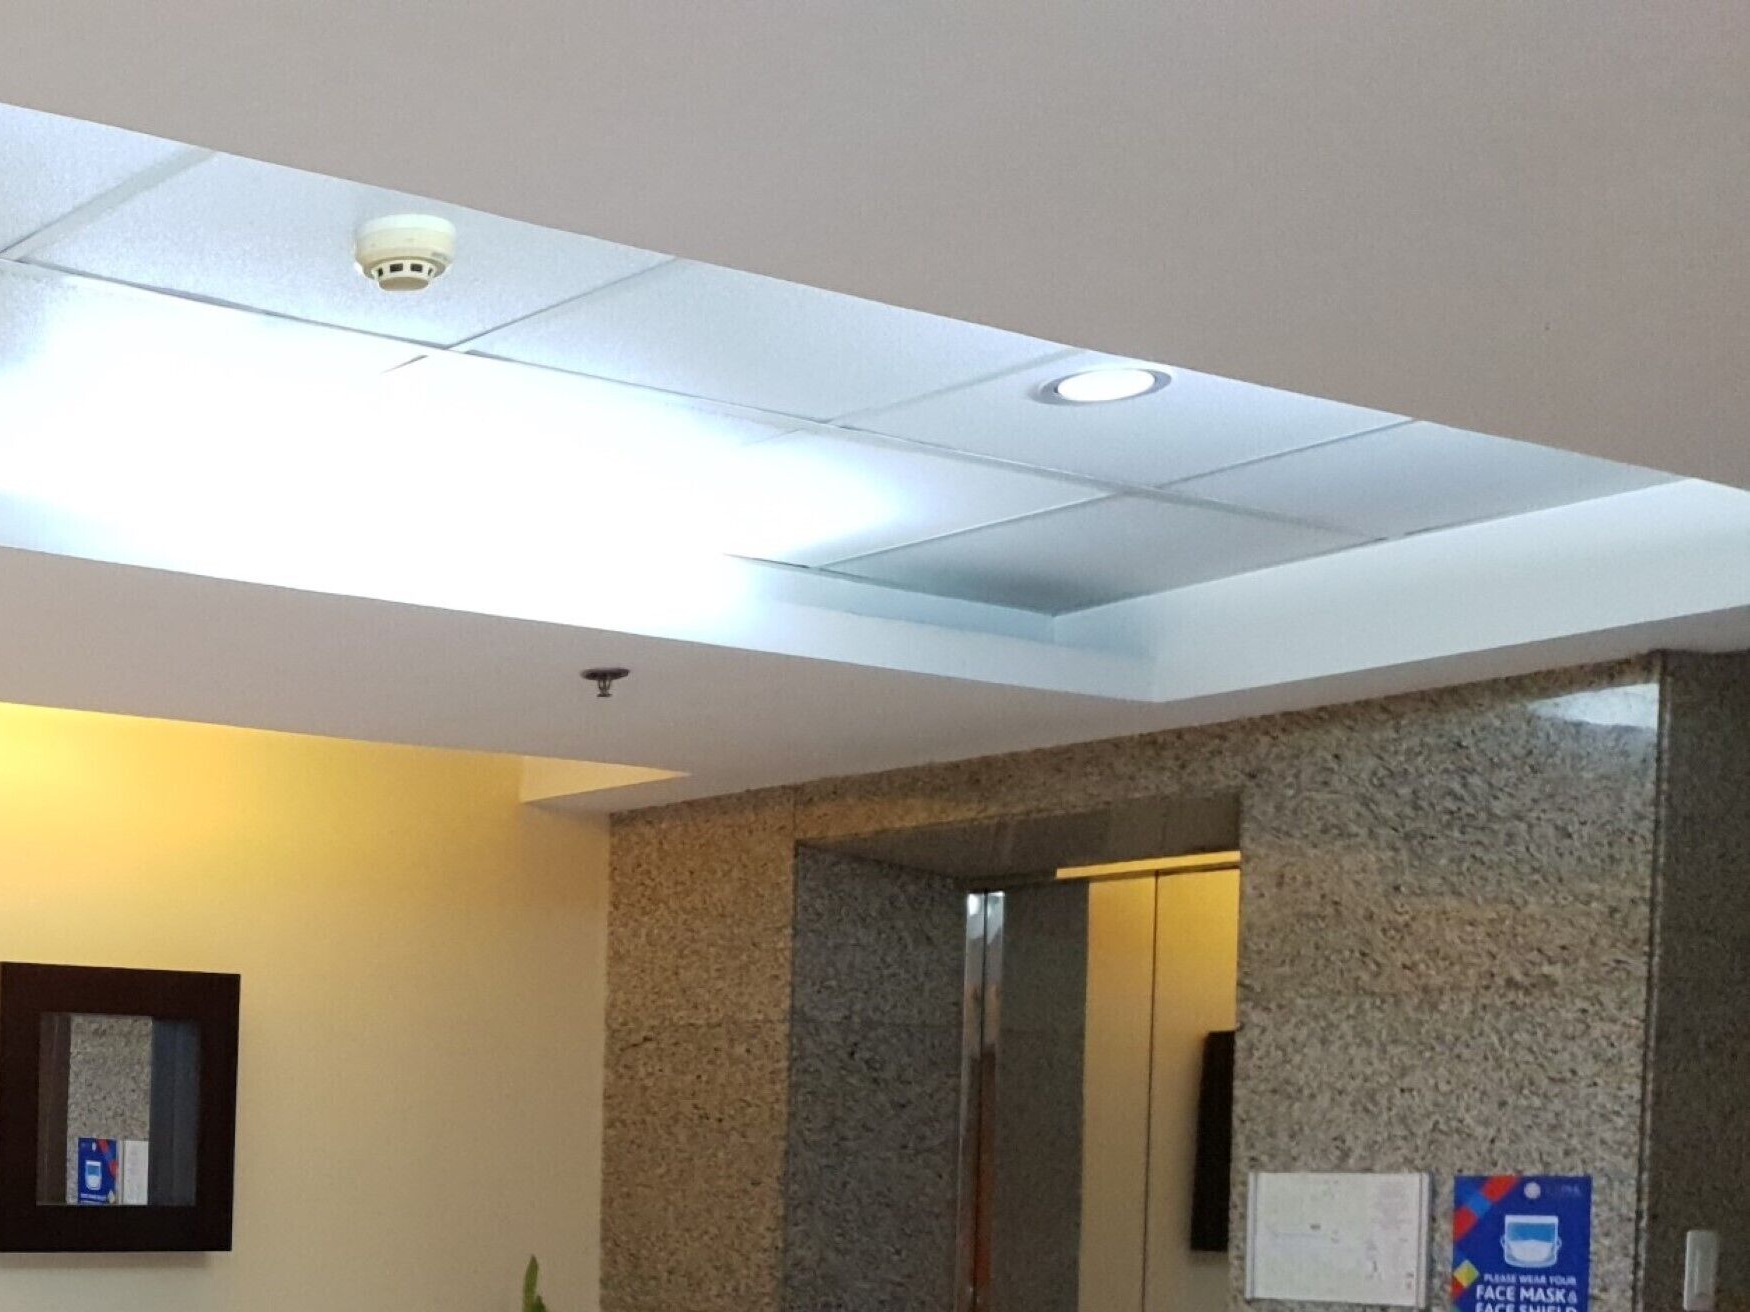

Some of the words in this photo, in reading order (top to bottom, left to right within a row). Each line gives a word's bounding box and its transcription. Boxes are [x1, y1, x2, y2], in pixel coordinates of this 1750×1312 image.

[1483, 1273, 1517, 1284] PLEASE
[1519, 1274, 1547, 1285] WEAR
[1549, 1275, 1577, 1286] YOUR
[1476, 1284, 1515, 1301] FACE
[1519, 1286, 1566, 1303] MASK
